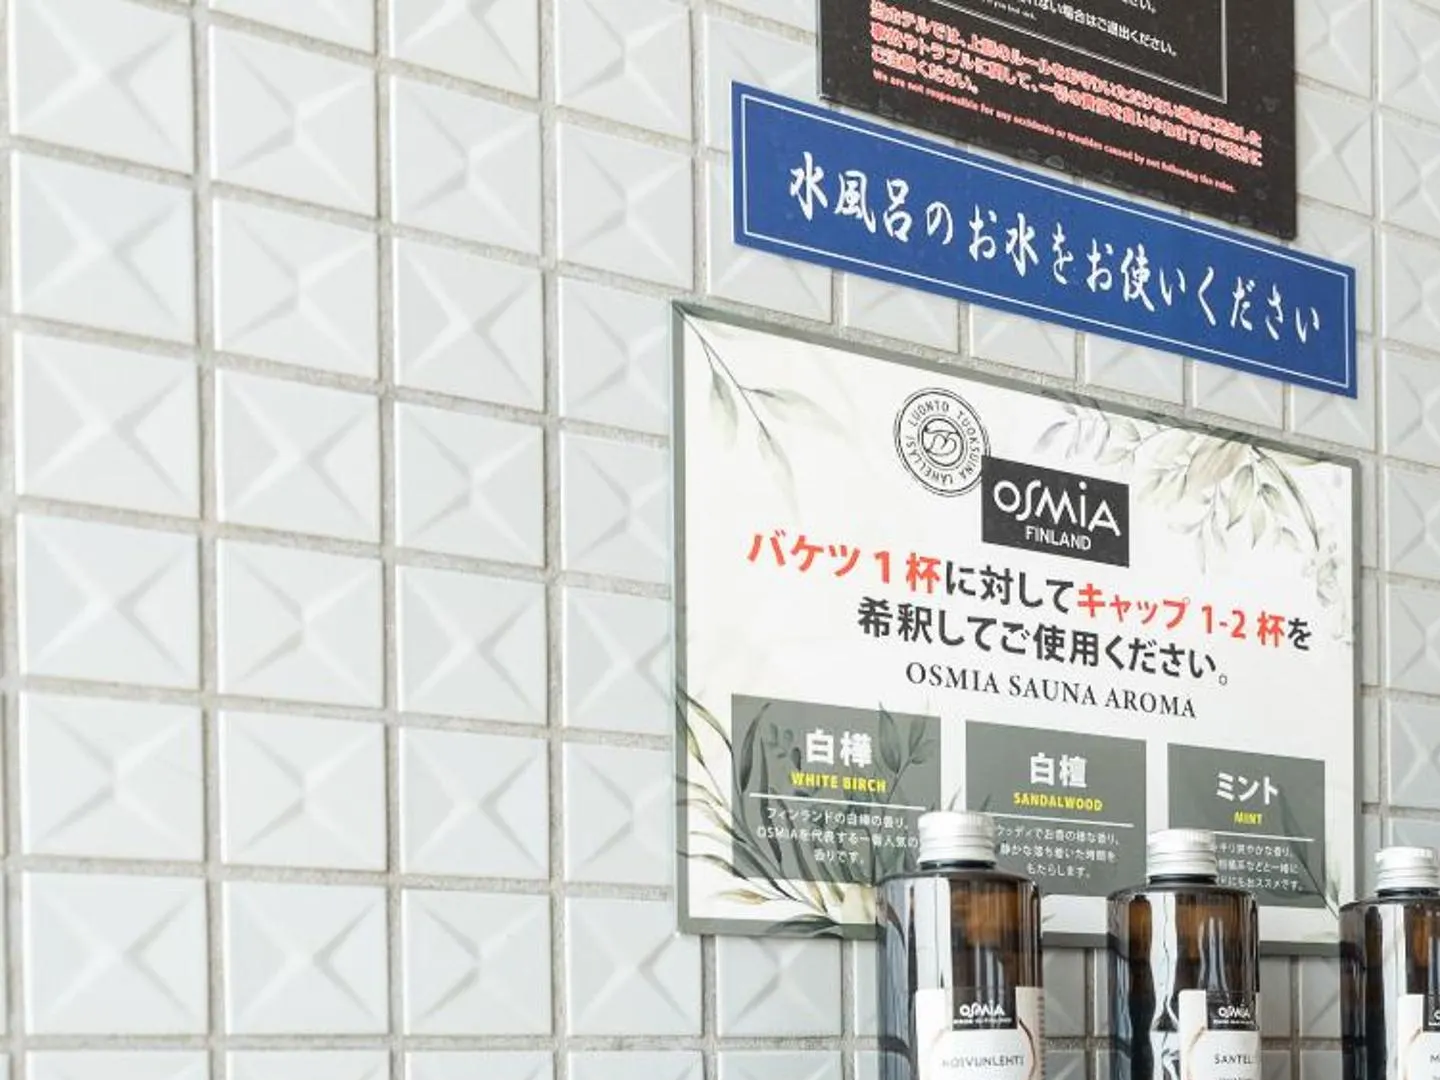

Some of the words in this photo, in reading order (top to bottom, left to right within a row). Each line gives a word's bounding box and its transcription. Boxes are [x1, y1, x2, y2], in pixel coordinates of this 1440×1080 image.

[789, 151, 1320, 344] 水風呂のお水をお使いください
[1025, 525, 1092, 550] FINLAND
[857, 596, 1229, 686] 希釈してご使用ください。
[905, 661, 1000, 693] OSMIA
[1008, 675, 1098, 707] SAUNA
[1104, 687, 1197, 718] AROMA
[805, 727, 873, 769] 白樺
[789, 770, 839, 790] WHITE
[842, 776, 887, 793] BIRCH
[1030, 752, 1088, 789] 白檀
[1013, 792, 1104, 812] SANDALWOOD
[1216, 772, 1279, 806] ミント
[1234, 811, 1263, 826] MINT
